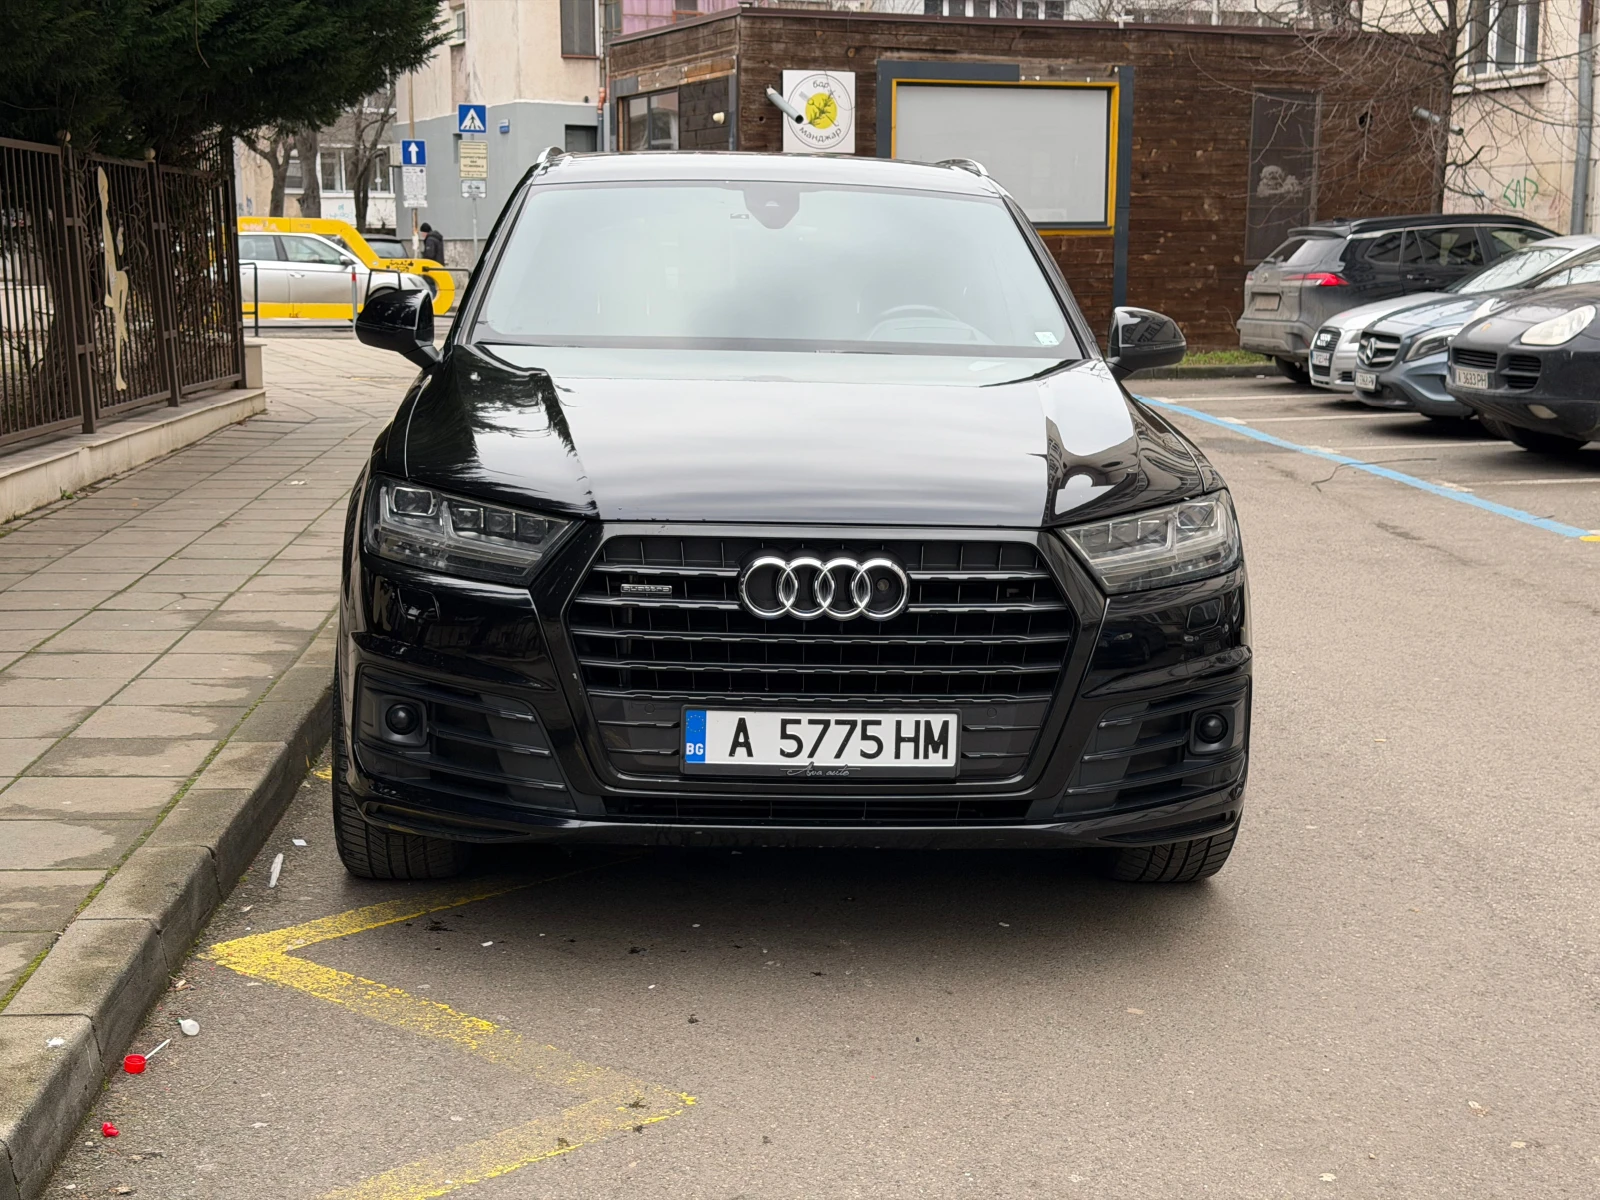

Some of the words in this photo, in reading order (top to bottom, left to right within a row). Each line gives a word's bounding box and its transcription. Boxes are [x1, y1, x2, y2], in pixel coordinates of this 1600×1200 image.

[812, 79, 829, 88] бар
[799, 127, 842, 142] манджар
[728, 717, 754, 758] A
[779, 718, 884, 760] 5775
[894, 719, 950, 760] HM
[686, 743, 704, 755] BG
